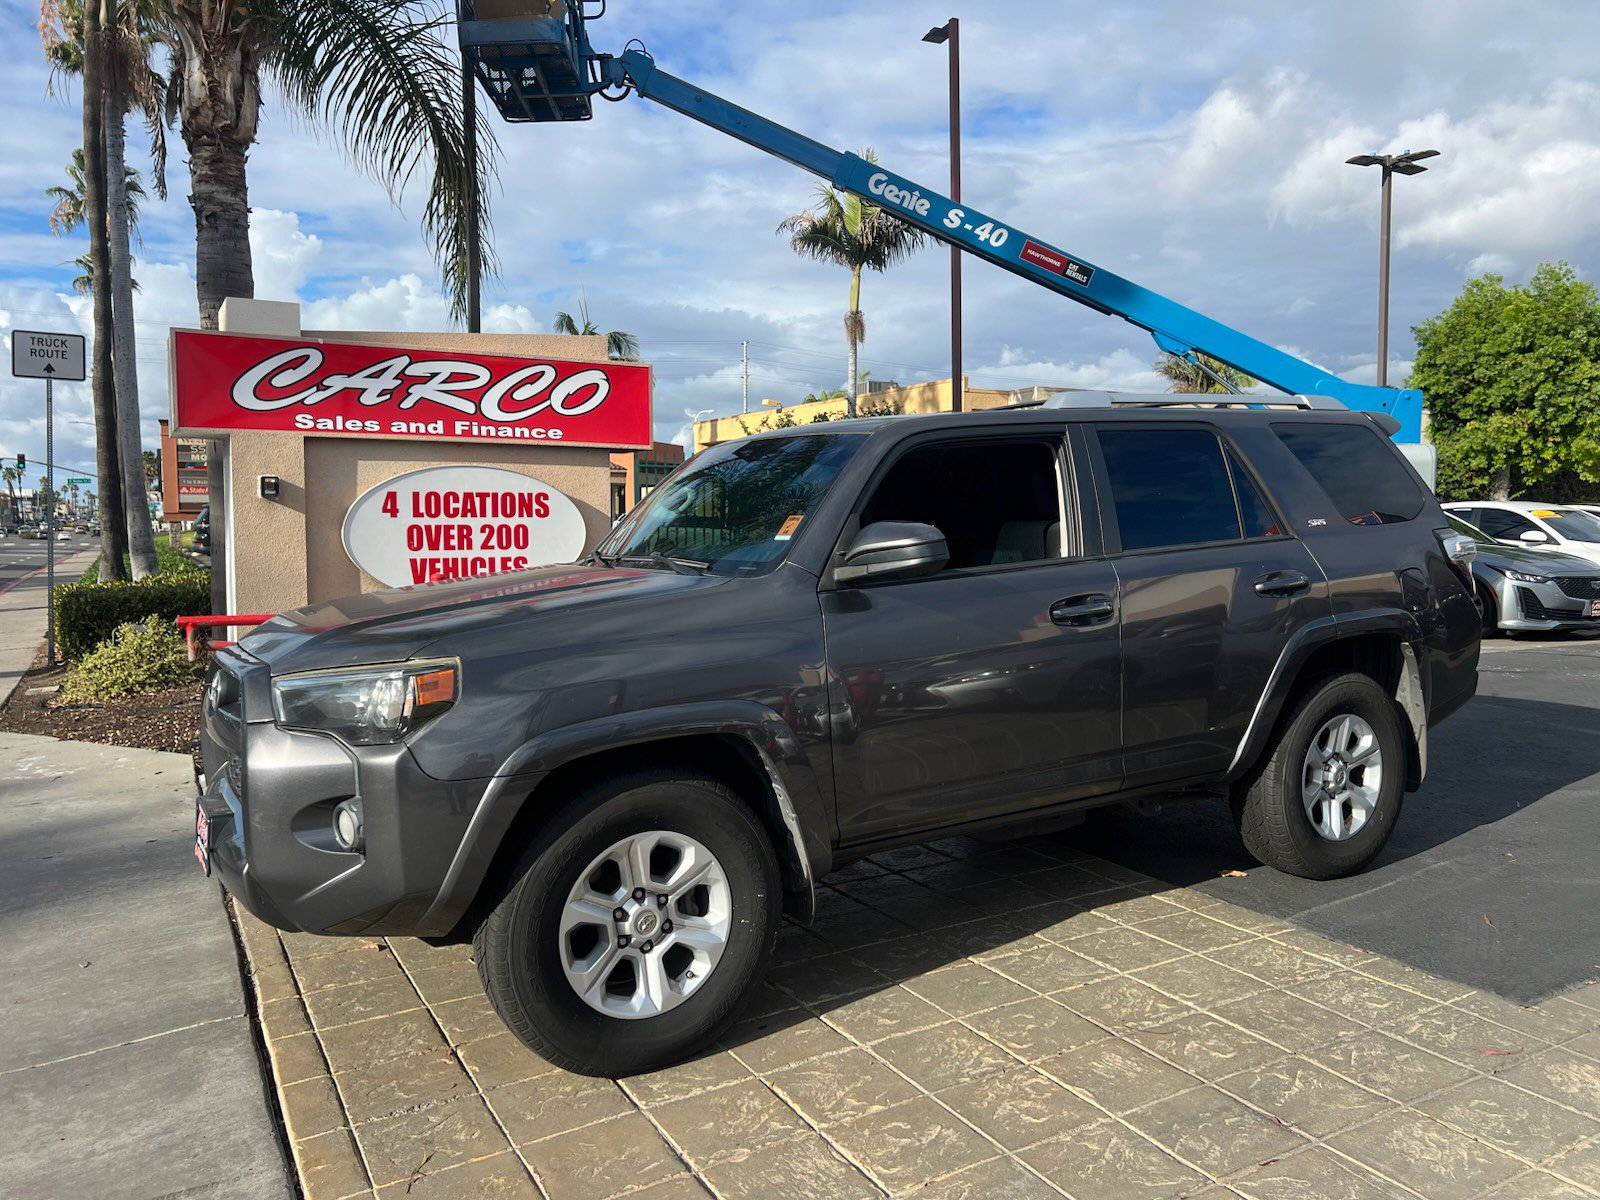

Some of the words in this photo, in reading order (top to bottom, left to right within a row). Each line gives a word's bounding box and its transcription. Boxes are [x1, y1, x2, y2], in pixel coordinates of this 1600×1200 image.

[868, 173, 930, 217] Genie
[943, 208, 1009, 247] S-40
[1027, 249, 1061, 267] HAWTHORNE
[1068, 263, 1079, 272] CAT
[1065, 269, 1088, 283] RENTALS
[30, 336, 68, 348] TRUCK
[30, 348, 68, 360] ROUTE
[231, 346, 611, 423] CARCO
[294, 413, 381, 432] Sales
[390, 420, 444, 435] and
[454, 420, 563, 439] Finance
[381, 491, 400, 518] 4
[412, 491, 550, 518] LOCATIONS
[406, 524, 473, 551] OVER
[479, 523, 529, 550] 200
